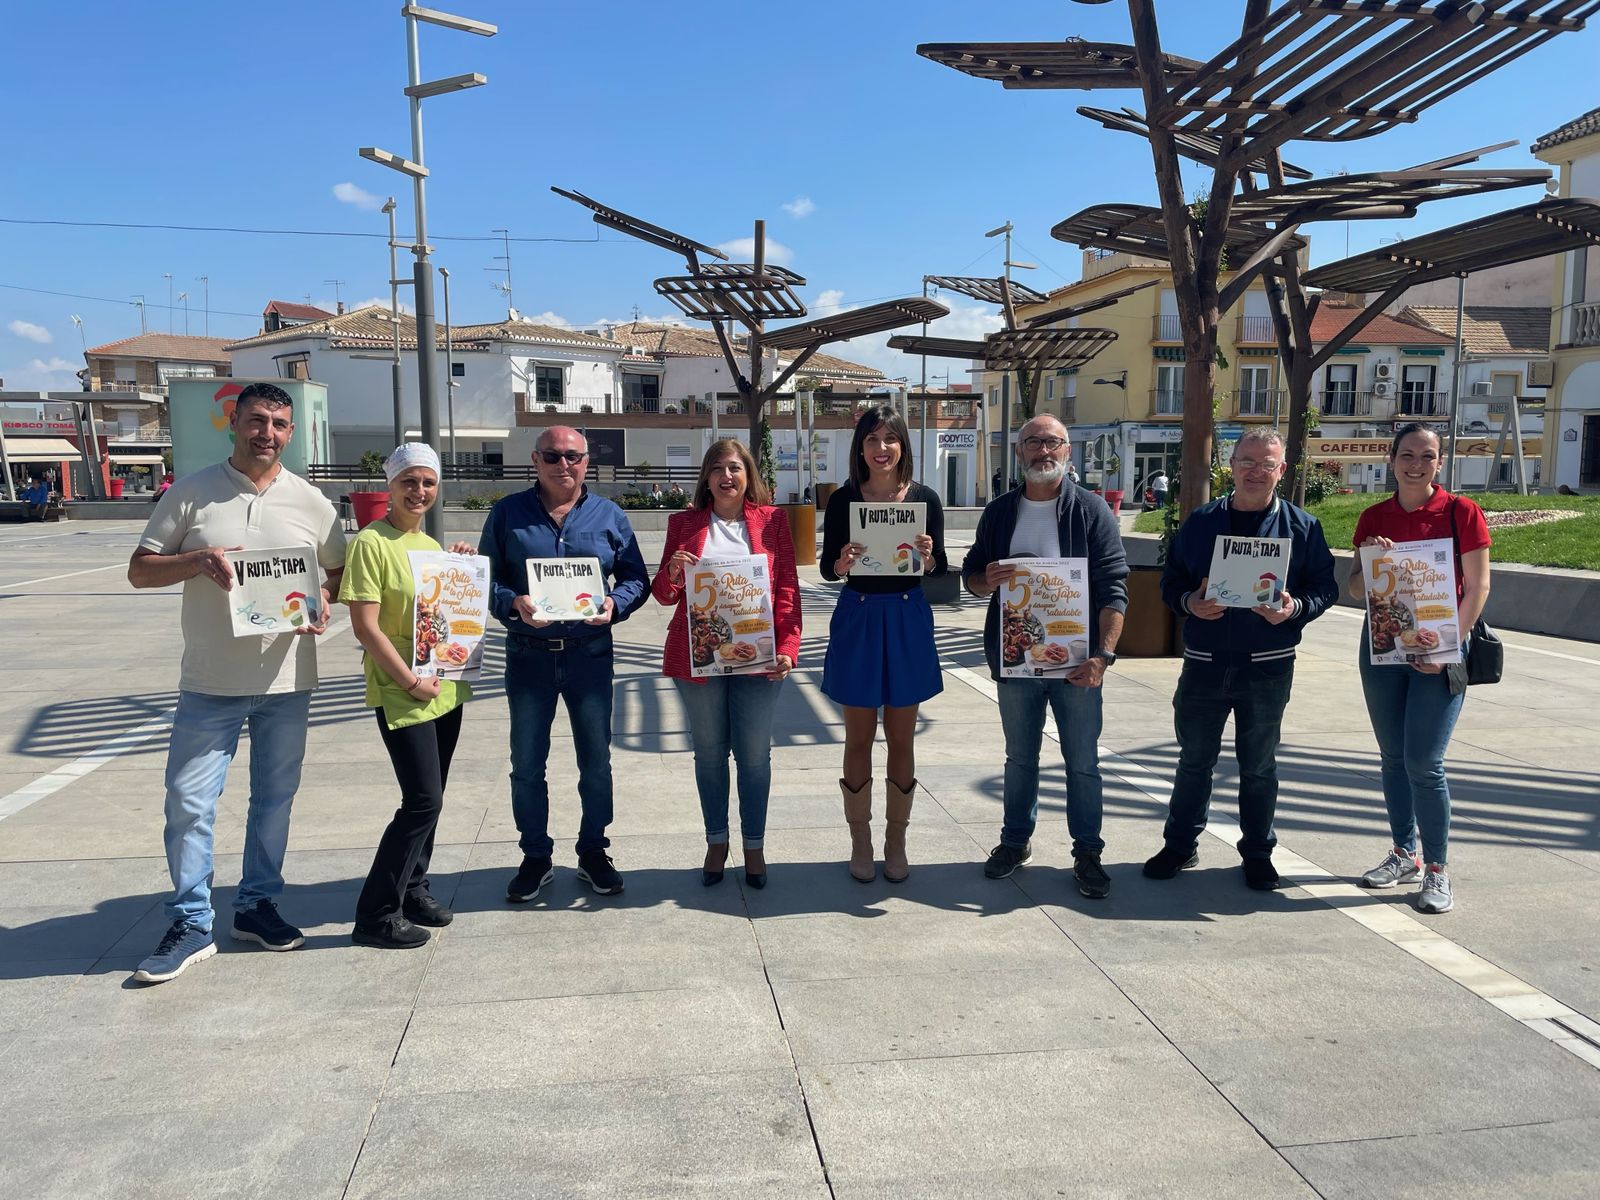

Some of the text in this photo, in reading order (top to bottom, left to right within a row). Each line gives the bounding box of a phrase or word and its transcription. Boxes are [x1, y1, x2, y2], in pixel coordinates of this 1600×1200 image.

[938, 434, 975, 443] BODYTEC
[1321, 442, 1393, 453] CAFETERÍ
[859, 507, 868, 529] V
[869, 509, 888, 523] RUTA
[889, 507, 895, 515] DE
[896, 509, 916, 523] TAPA
[1223, 538, 1280, 560] V RUTA DE LA TAPA
[234, 557, 306, 586] V RUTA DE LA TAPA
[533, 563, 541, 582] V
[543, 565, 565, 577] RUTA
[572, 564, 593, 576] TAPA
[1400, 558, 1428, 576] Ruta
[447, 568, 471, 587] Ruta
[721, 572, 748, 591] Ruta
[1036, 573, 1065, 591] Ruta
[1416, 569, 1447, 587] Tapa
[457, 584, 482, 603] Tapa
[736, 583, 764, 602] Tapa
[1050, 585, 1081, 603] Tapa
